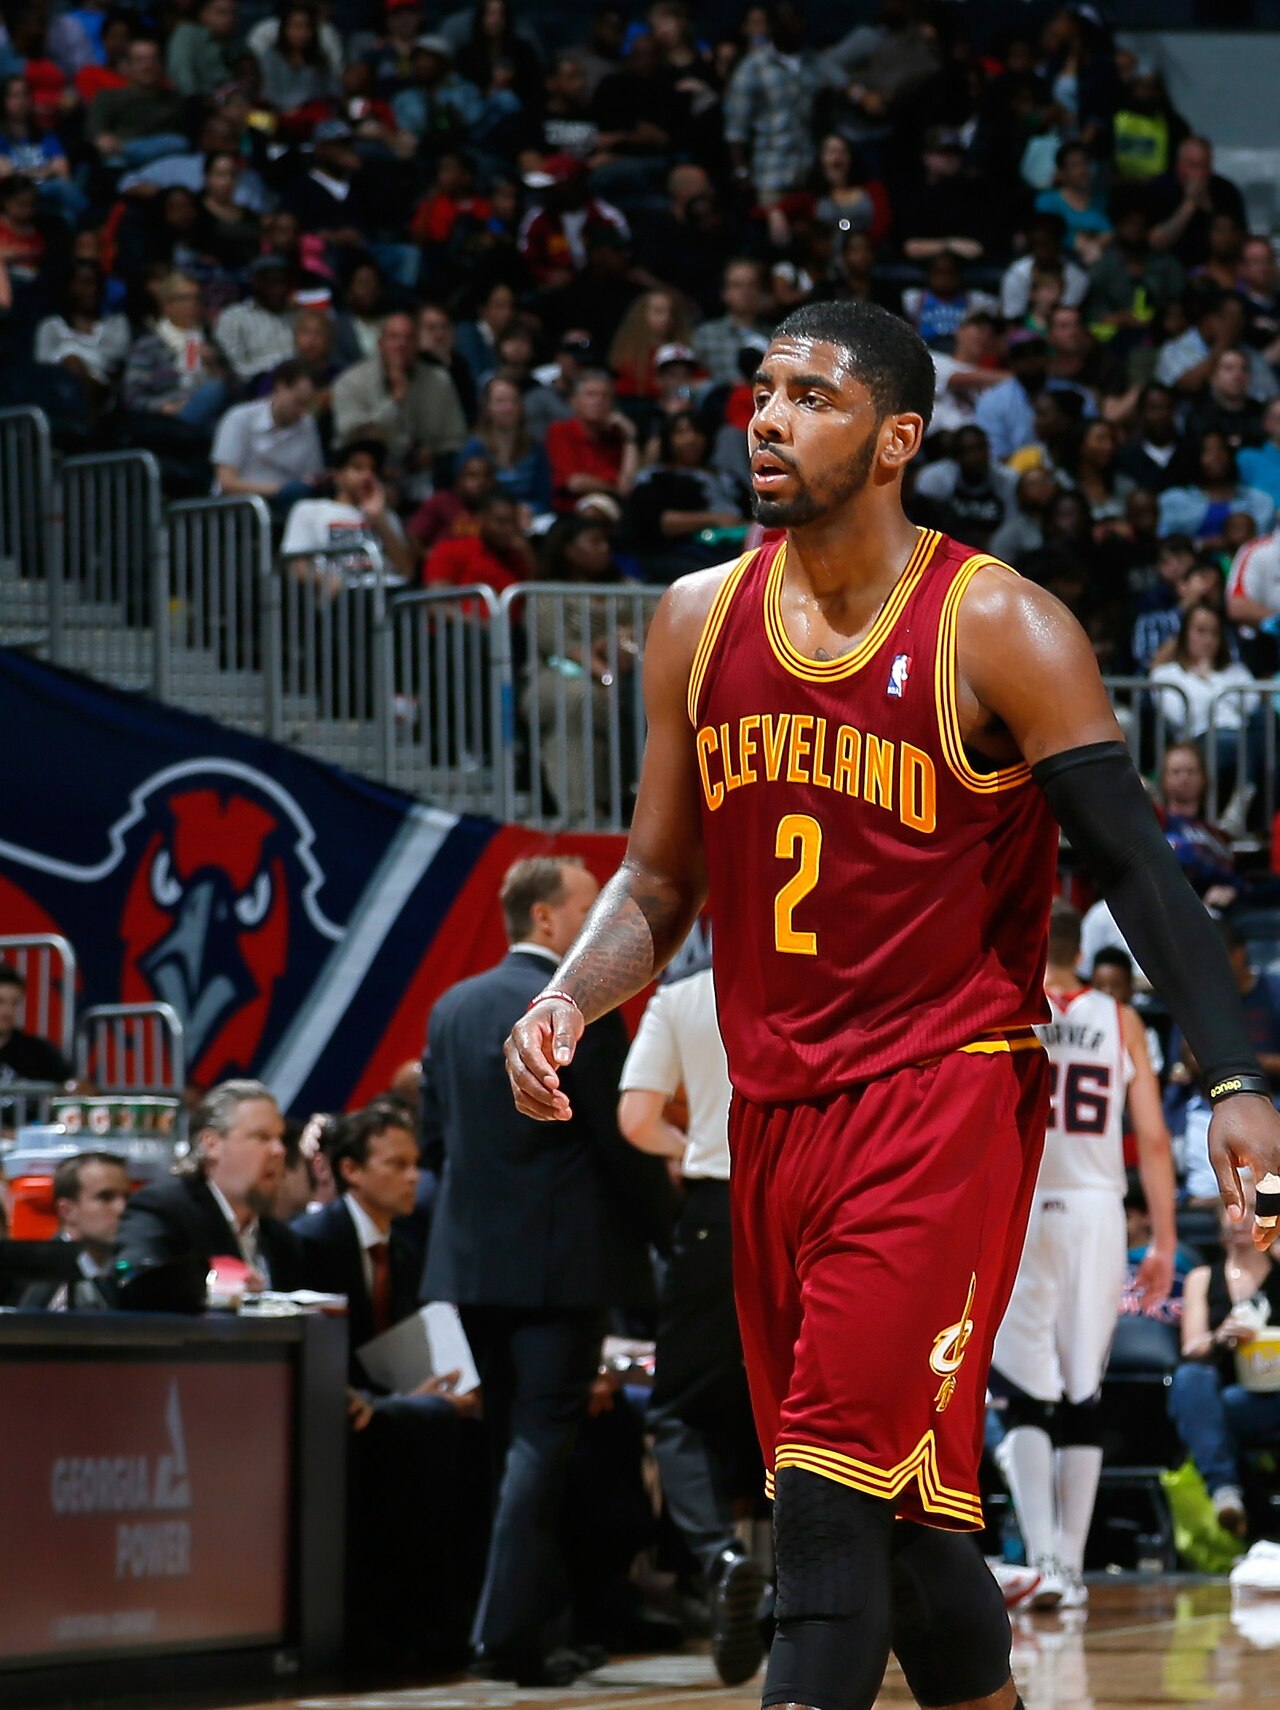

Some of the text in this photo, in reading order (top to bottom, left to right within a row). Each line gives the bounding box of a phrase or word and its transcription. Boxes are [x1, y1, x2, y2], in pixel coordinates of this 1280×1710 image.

[696, 713, 937, 834] CLEVELAND
[774, 814, 823, 956] 2
[1042, 1022, 1105, 1050] ORVER
[1210, 1079, 1242, 1098] deuce
[52, 1455, 149, 1513] GEORGIA
[115, 1519, 191, 1579] POWER
